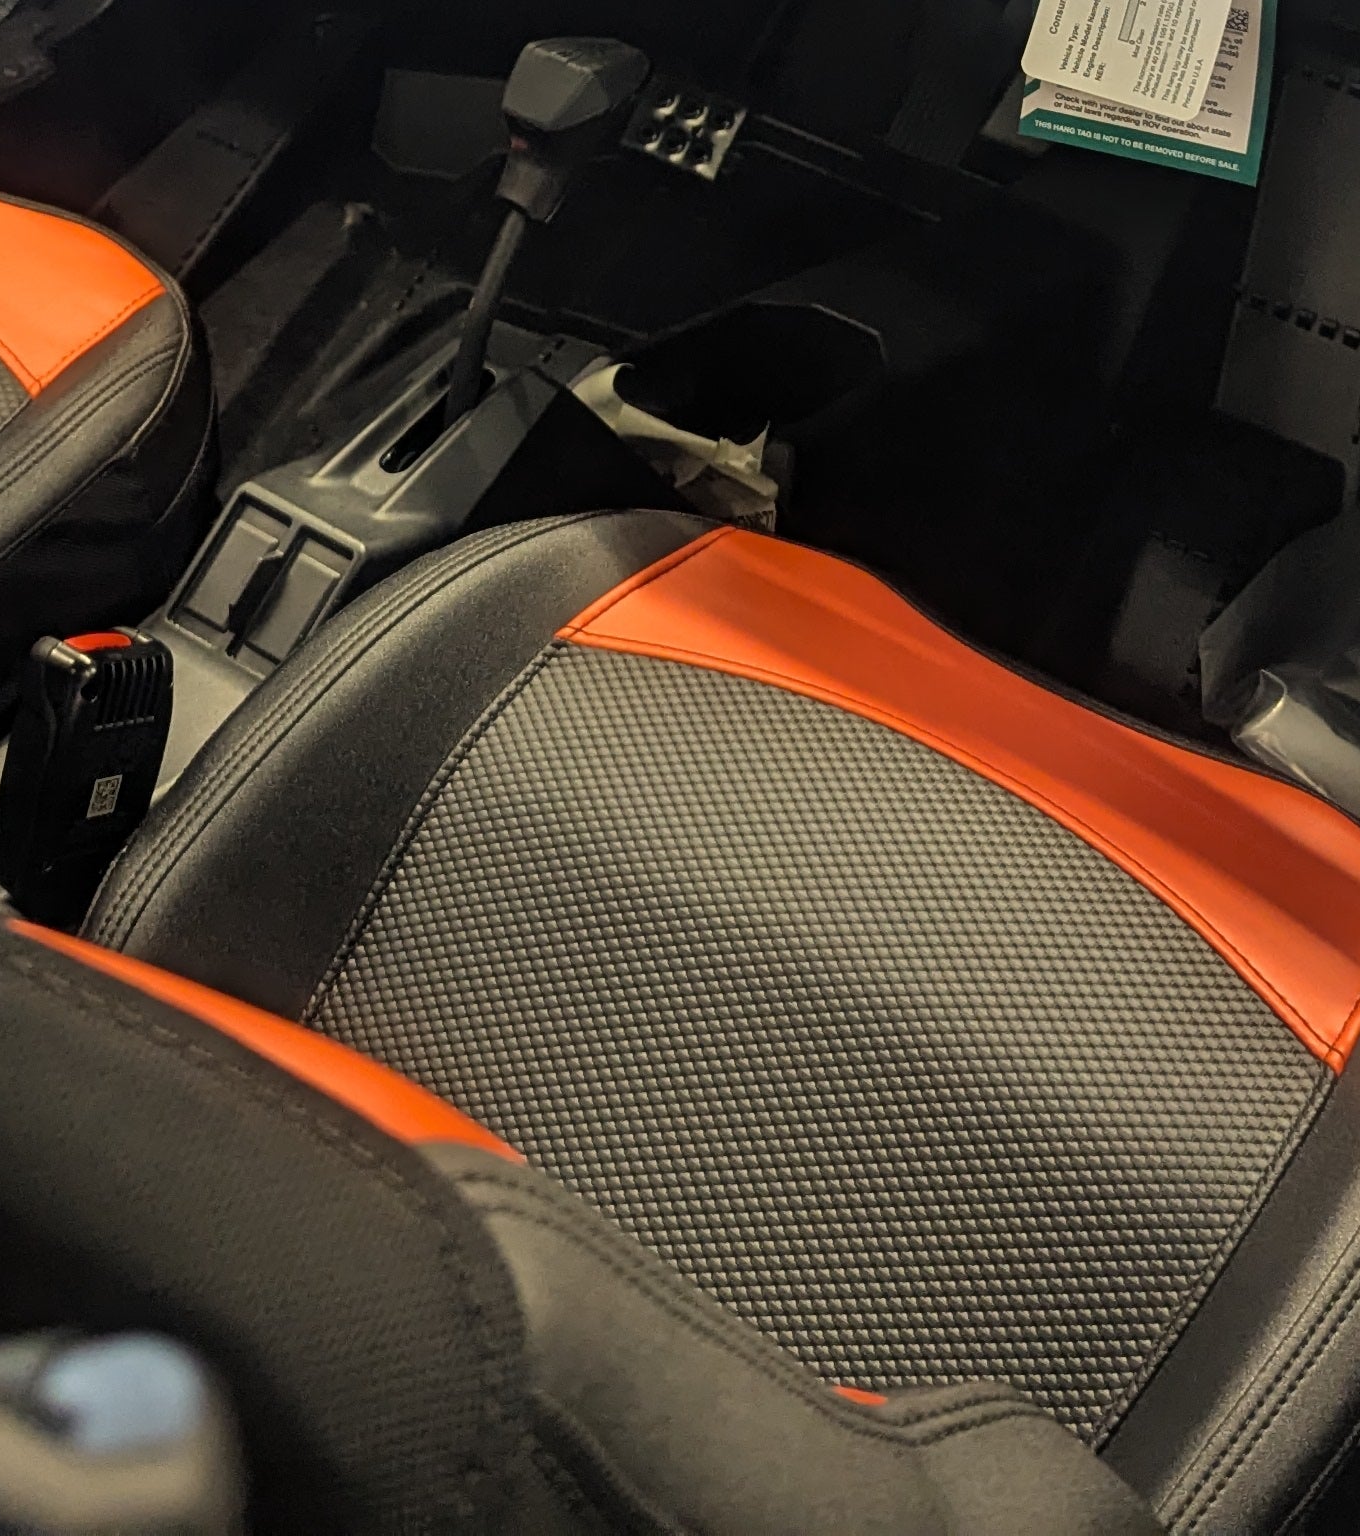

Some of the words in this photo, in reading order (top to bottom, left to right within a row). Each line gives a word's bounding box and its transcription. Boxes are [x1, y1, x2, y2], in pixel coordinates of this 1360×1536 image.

[1080, 24, 1092, 47] Model
[1083, 52, 1097, 78] Engine
[1055, 92, 1080, 104] Check
[1081, 99, 1098, 108] with
[1144, 112, 1153, 120] to
[1064, 102, 1083, 113] local
[1104, 110, 1141, 126] regarding
[1034, 119, 1052, 129] THIS
[1053, 124, 1076, 134] HANG
[1077, 128, 1092, 138] TAG
[1093, 132, 1101, 140] IS
[1102, 134, 1119, 144] NOT
[1120, 138, 1132, 147] TO
[1132, 141, 1144, 150] BE
[1144, 144, 1184, 158] REMOVED
[1184, 153, 1217, 167] BEFORE
[1218, 161, 1240, 172] SALE.
